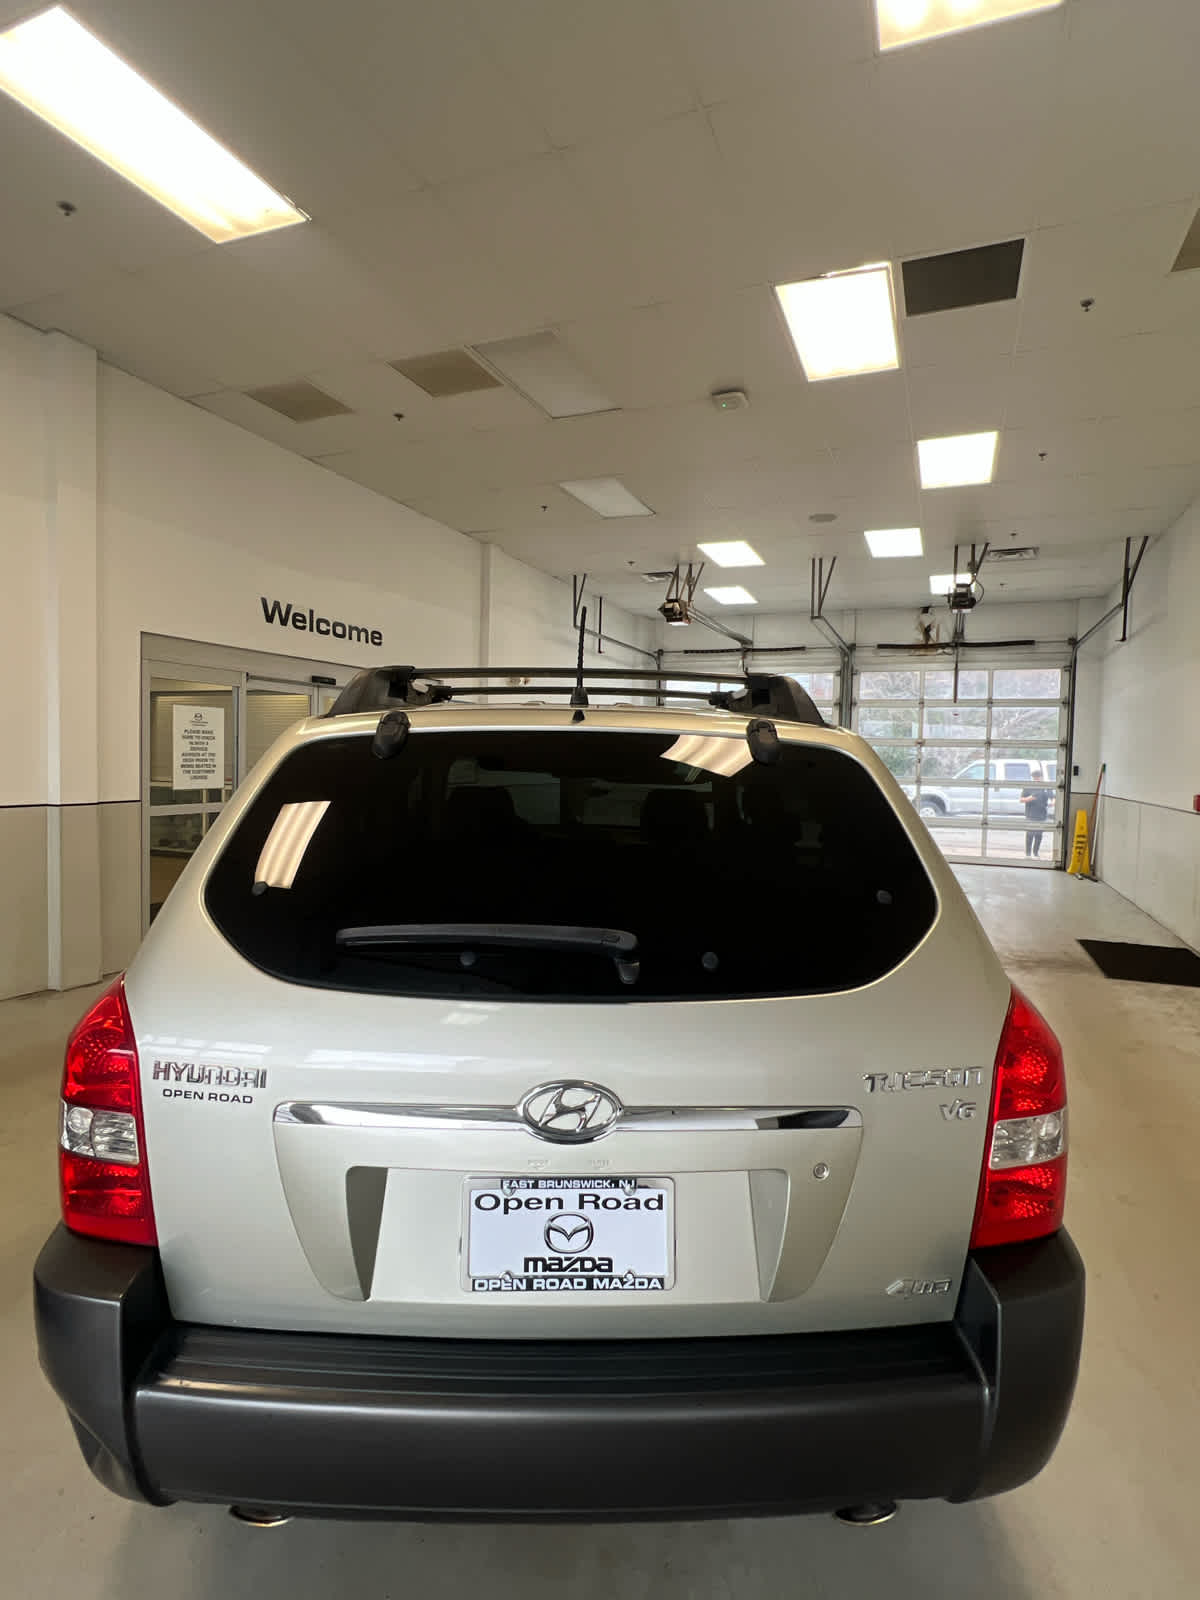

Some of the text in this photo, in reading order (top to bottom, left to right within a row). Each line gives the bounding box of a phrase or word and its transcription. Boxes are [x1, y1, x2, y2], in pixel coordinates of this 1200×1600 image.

[261, 597, 382, 646] Welcome
[152, 1060, 267, 1088] HYUNDAI
[862, 1066, 983, 1092] TUCSON
[162, 1088, 253, 1104] OPEN ROAD
[502, 1180, 534, 1189] EAST
[538, 1180, 615, 1189] BRUNSWICK,
[474, 1193, 664, 1215] Open Road
[474, 1279, 662, 1290] OPEN ROAD MAZDA
